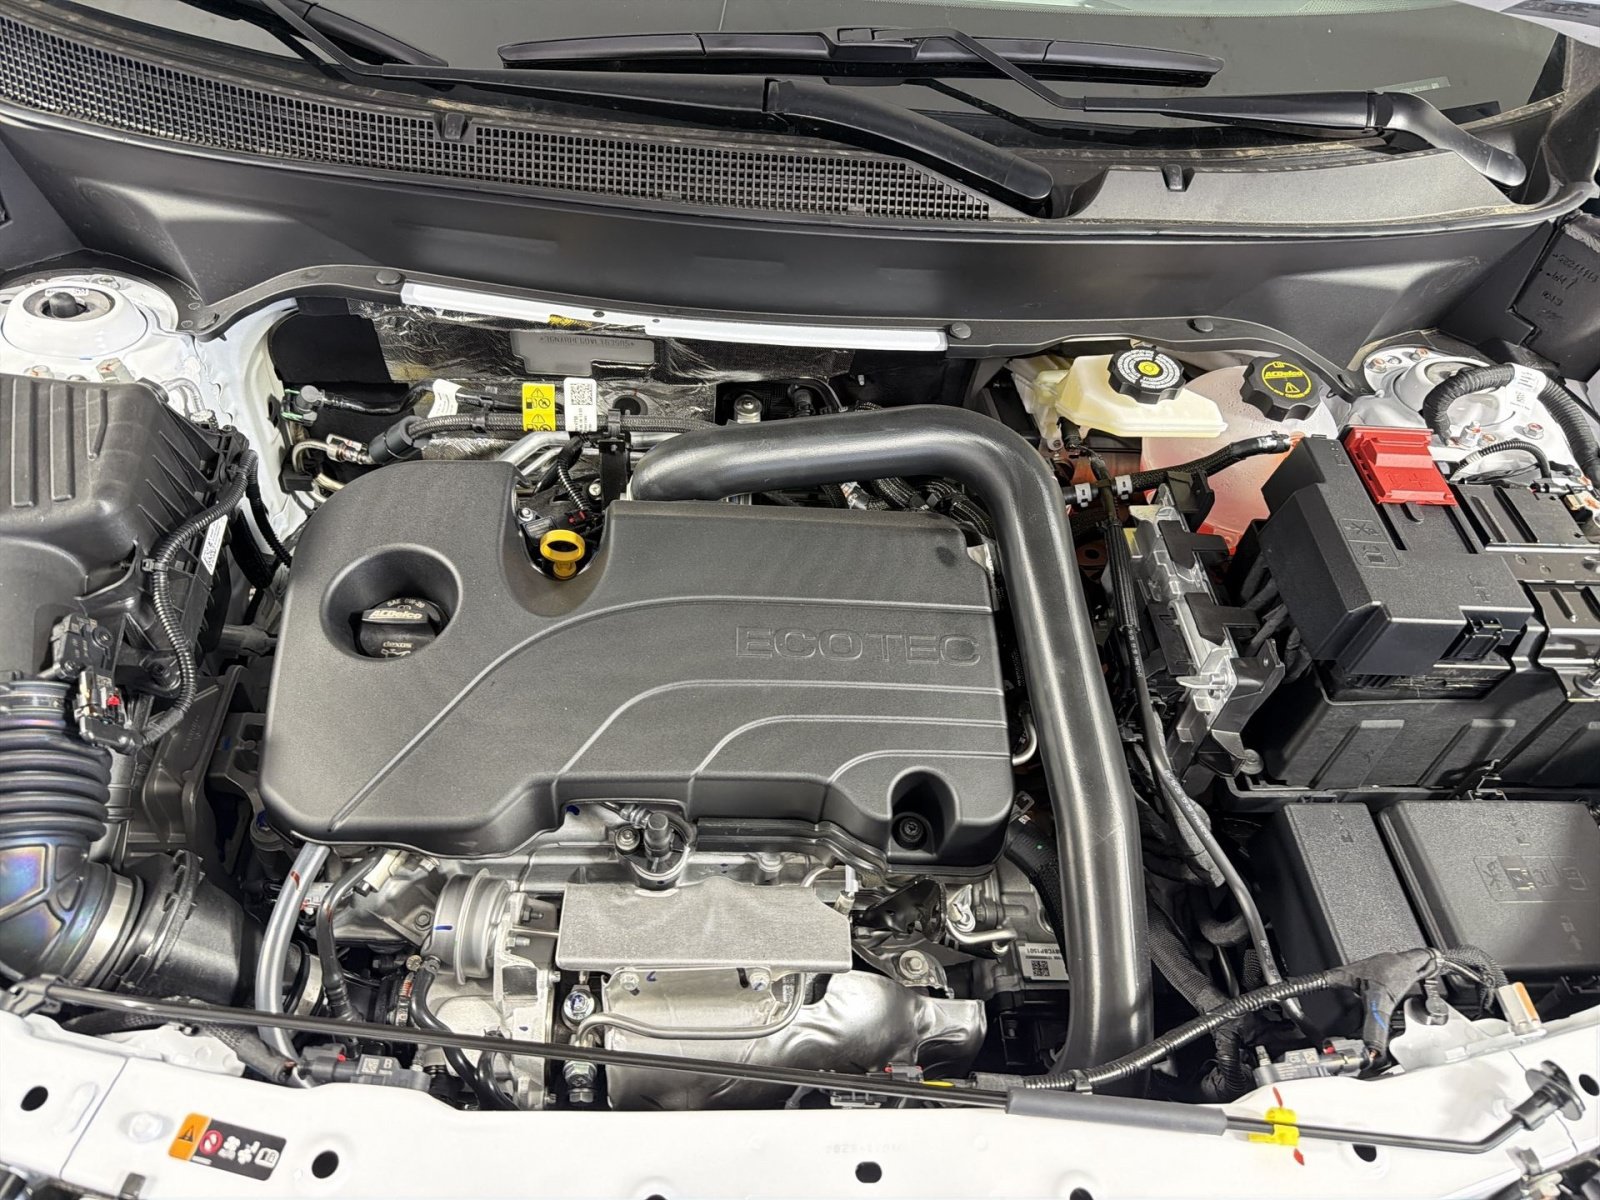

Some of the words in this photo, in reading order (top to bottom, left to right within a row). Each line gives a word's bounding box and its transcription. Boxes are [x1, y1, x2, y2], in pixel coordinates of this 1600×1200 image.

[368, 609, 423, 619] ACDelco
[382, 641, 412, 649] dexos
[735, 626, 981, 667] ECOTEC
